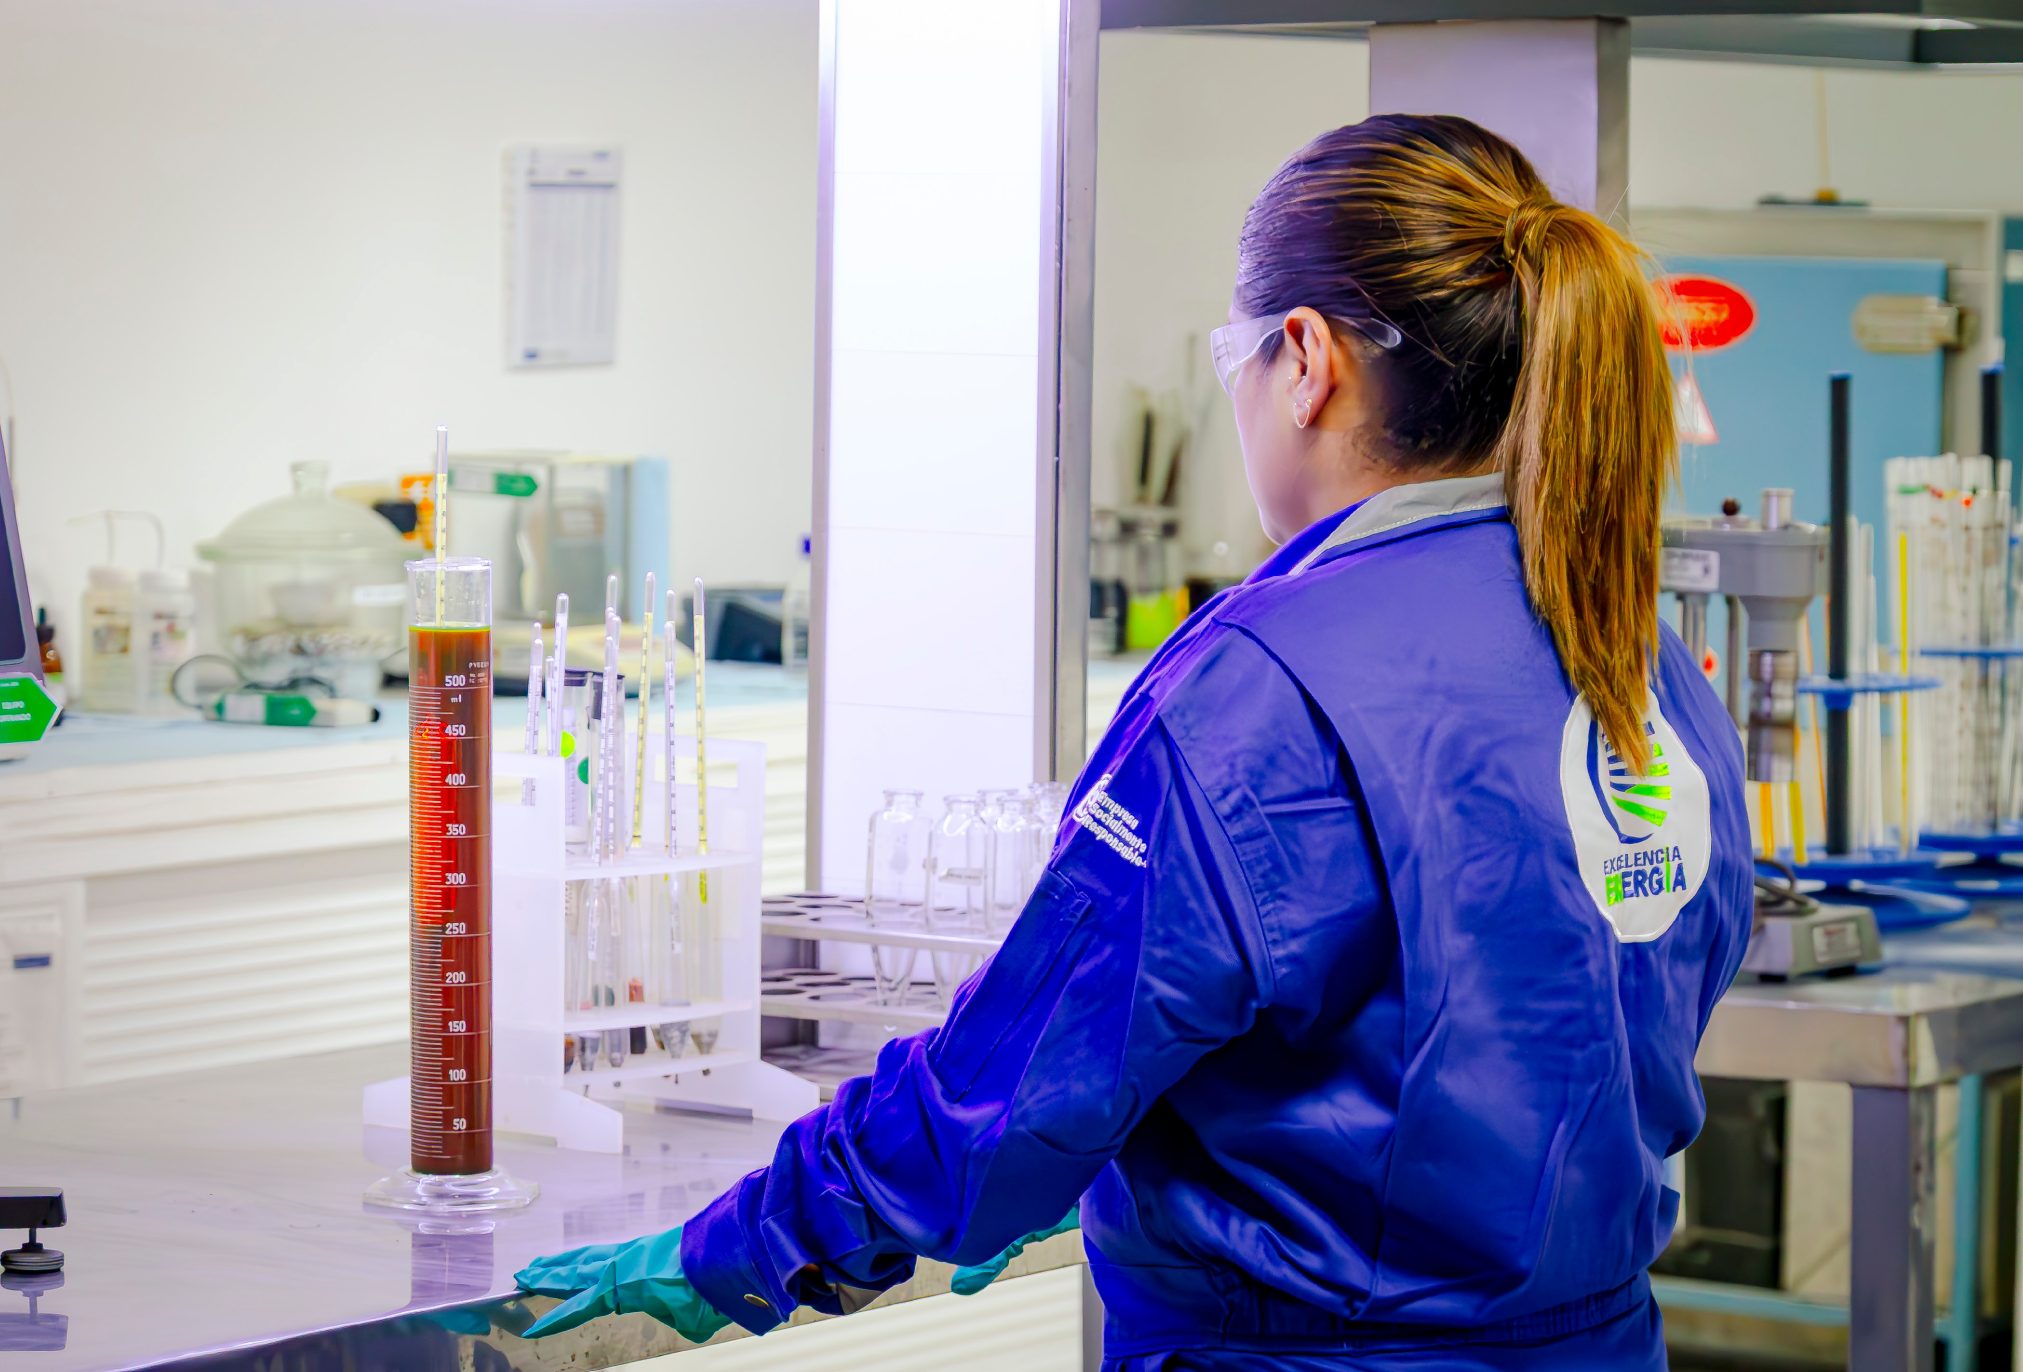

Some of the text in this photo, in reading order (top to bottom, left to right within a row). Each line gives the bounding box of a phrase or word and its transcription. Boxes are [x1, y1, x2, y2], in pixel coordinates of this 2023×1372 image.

[444, 674, 466, 687] 500
[450, 693, 462, 703] ml
[444, 723, 466, 737] 450
[444, 773, 467, 786] 400
[1099, 790, 1139, 830] Empresa
[445, 823, 467, 836] 350
[1090, 801, 1147, 853] Socialmente
[1081, 812, 1143, 867] Responsable
[444, 872, 467, 885] 300
[444, 922, 467, 935] 250
[444, 971, 467, 984] 200
[447, 1020, 467, 1034] 150
[447, 1068, 467, 1082] 100
[452, 1118, 468, 1131] 50
